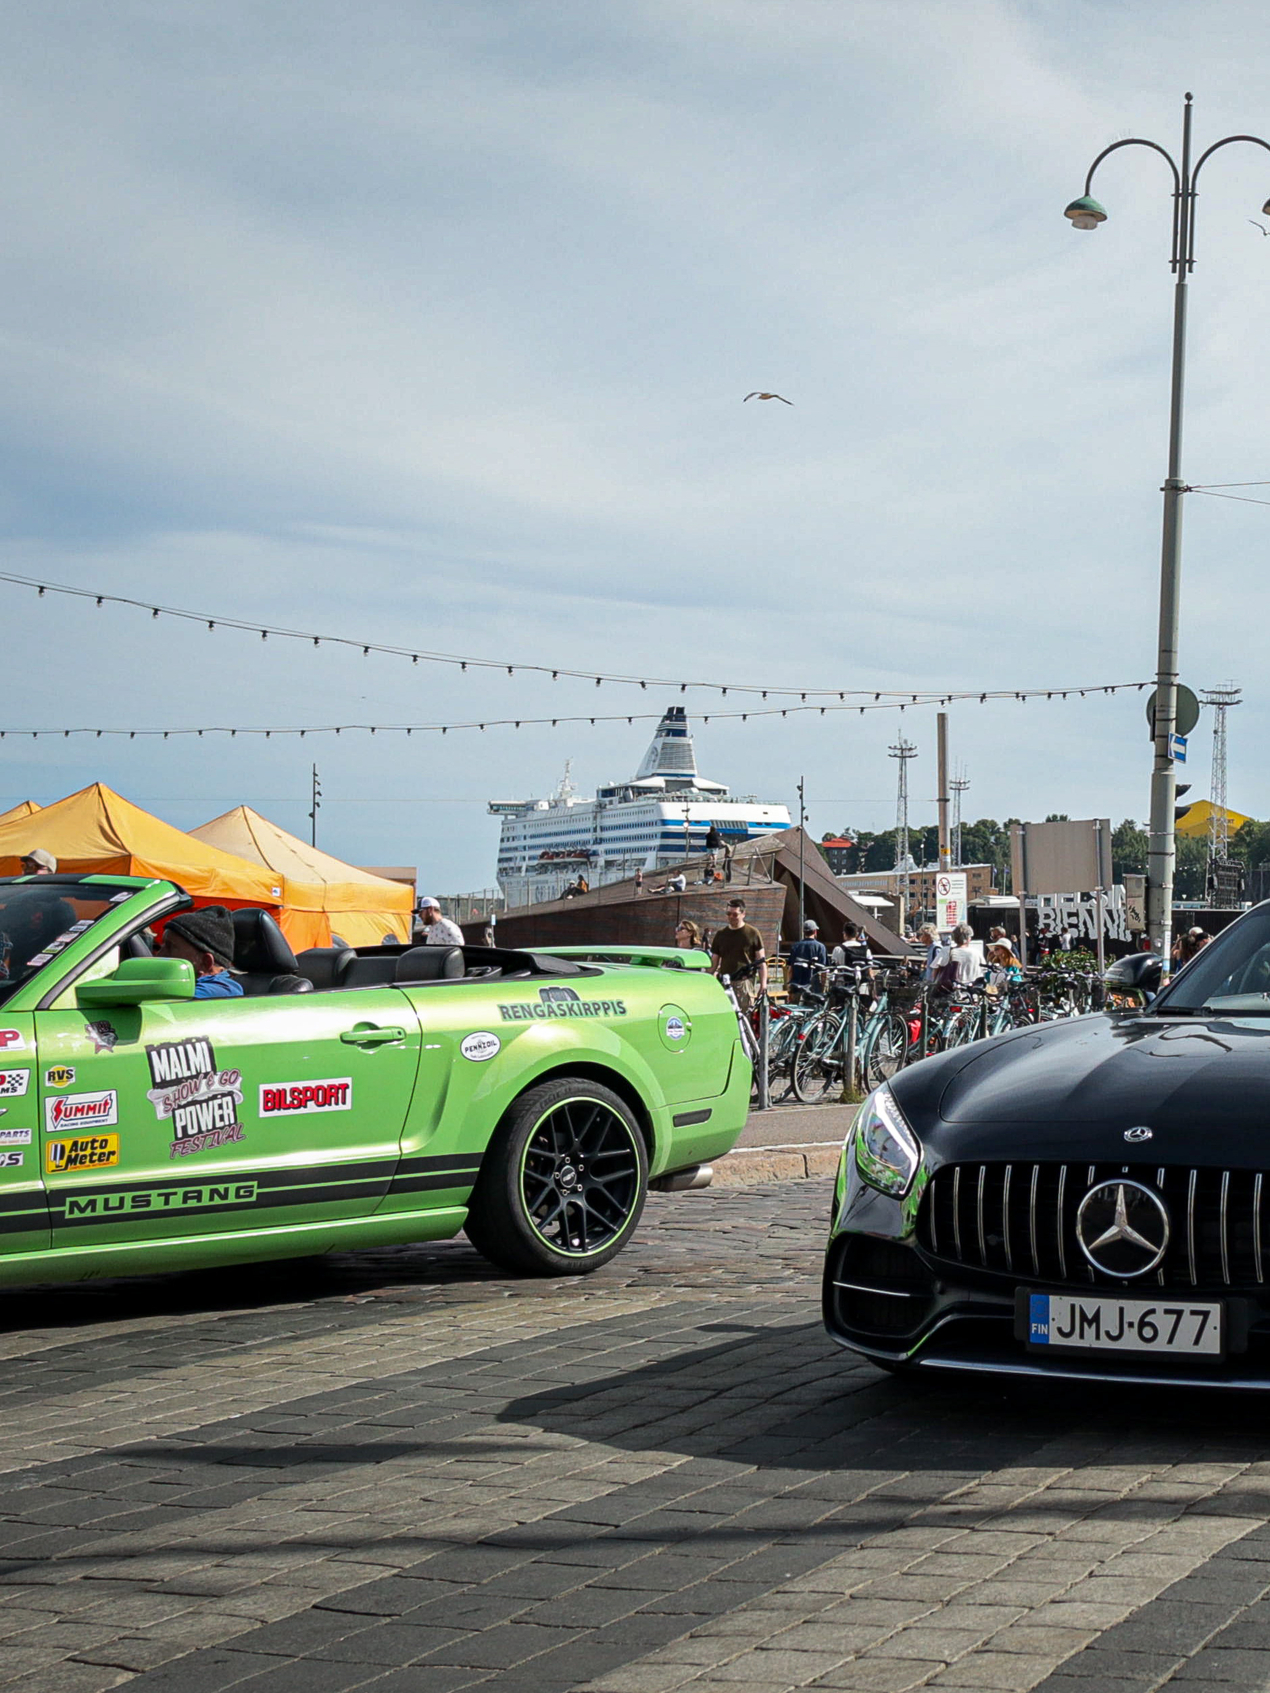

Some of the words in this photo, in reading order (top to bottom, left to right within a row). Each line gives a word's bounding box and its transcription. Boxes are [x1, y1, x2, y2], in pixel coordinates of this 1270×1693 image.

[500, 1000, 627, 1020] RENGASKIRPPIS
[150, 1040, 212, 1083] MALMI
[464, 1040, 497, 1053] PENNZOIL
[47, 1068, 74, 1082] RVS
[163, 1074, 205, 1114] SHOW
[218, 1068, 241, 1087] GO
[263, 1083, 349, 1112] BILSPORT
[174, 1096, 236, 1139] POWER
[69, 1137, 109, 1154] Auto
[169, 1123, 246, 1160] FESTIVAL
[65, 1150, 117, 1170] Meter
[68, 1184, 255, 1216] MUSTANG
[1031, 1323, 1048, 1335] FIN
[1056, 1303, 1212, 1346] JMJ-677
